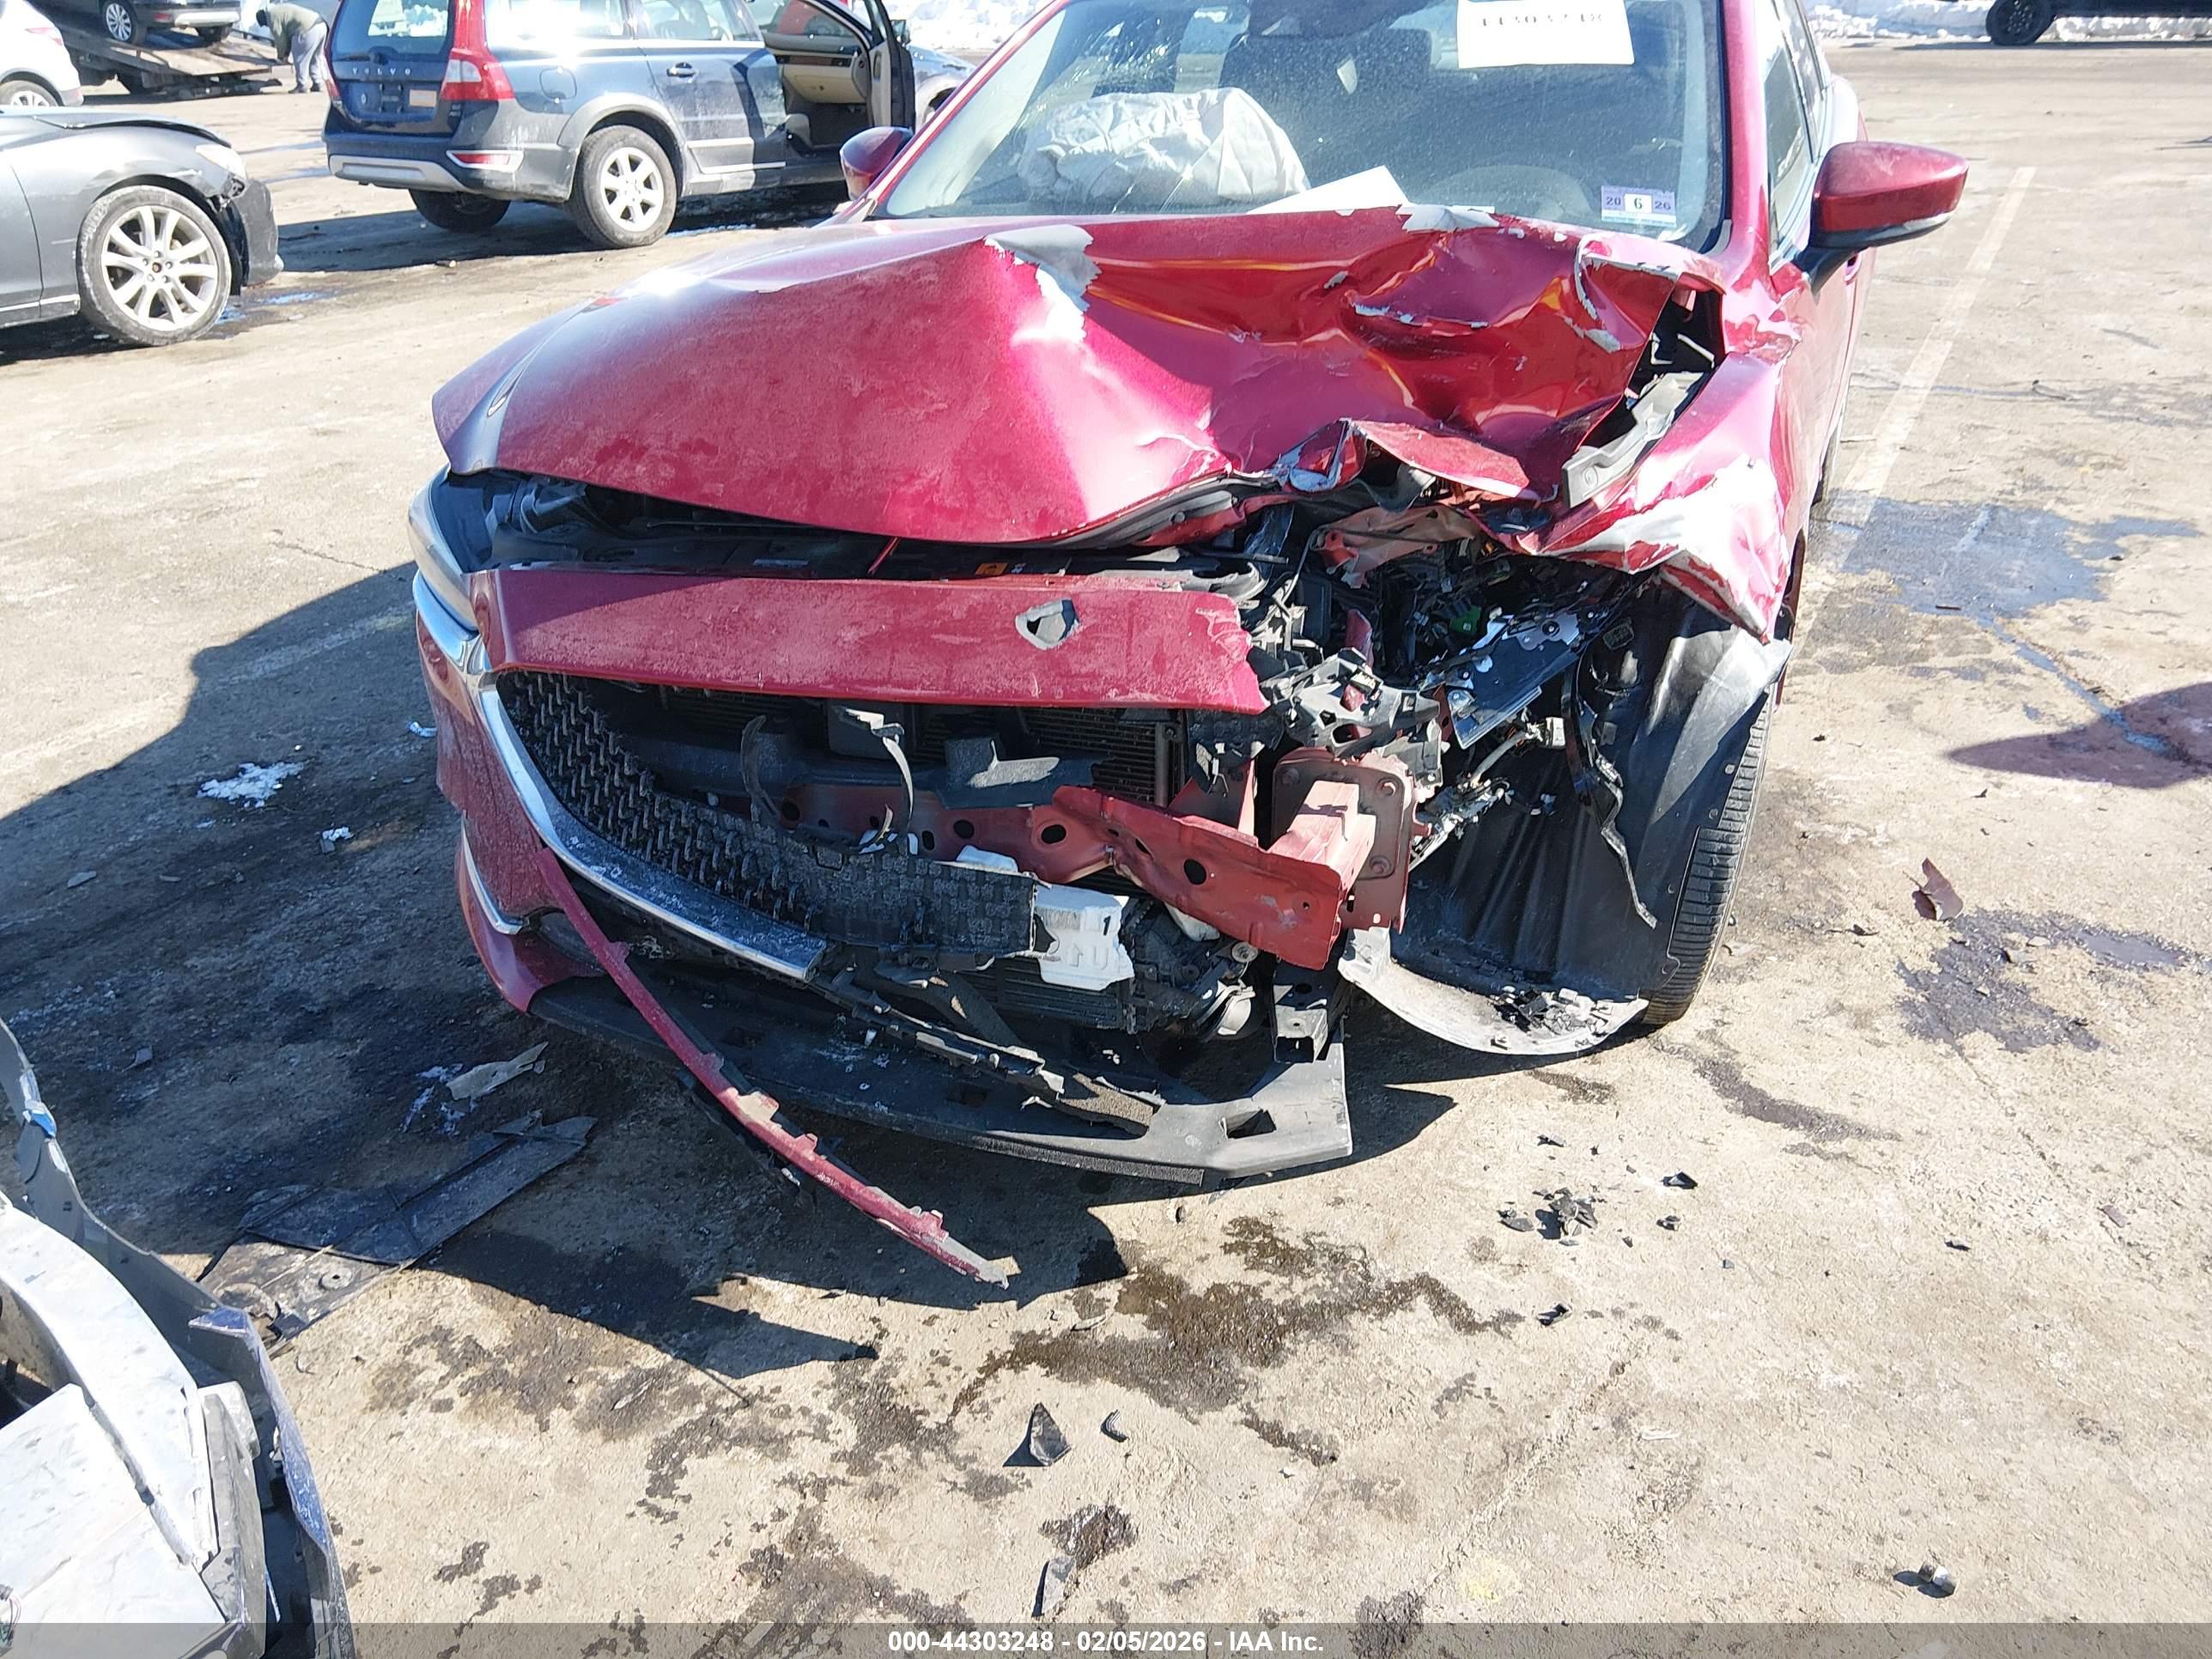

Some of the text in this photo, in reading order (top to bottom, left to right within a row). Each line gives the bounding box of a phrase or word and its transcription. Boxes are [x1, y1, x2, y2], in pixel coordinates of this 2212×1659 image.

[352, 68, 411, 76] VOLVO
[1606, 196, 1672, 210] 20 6 26
